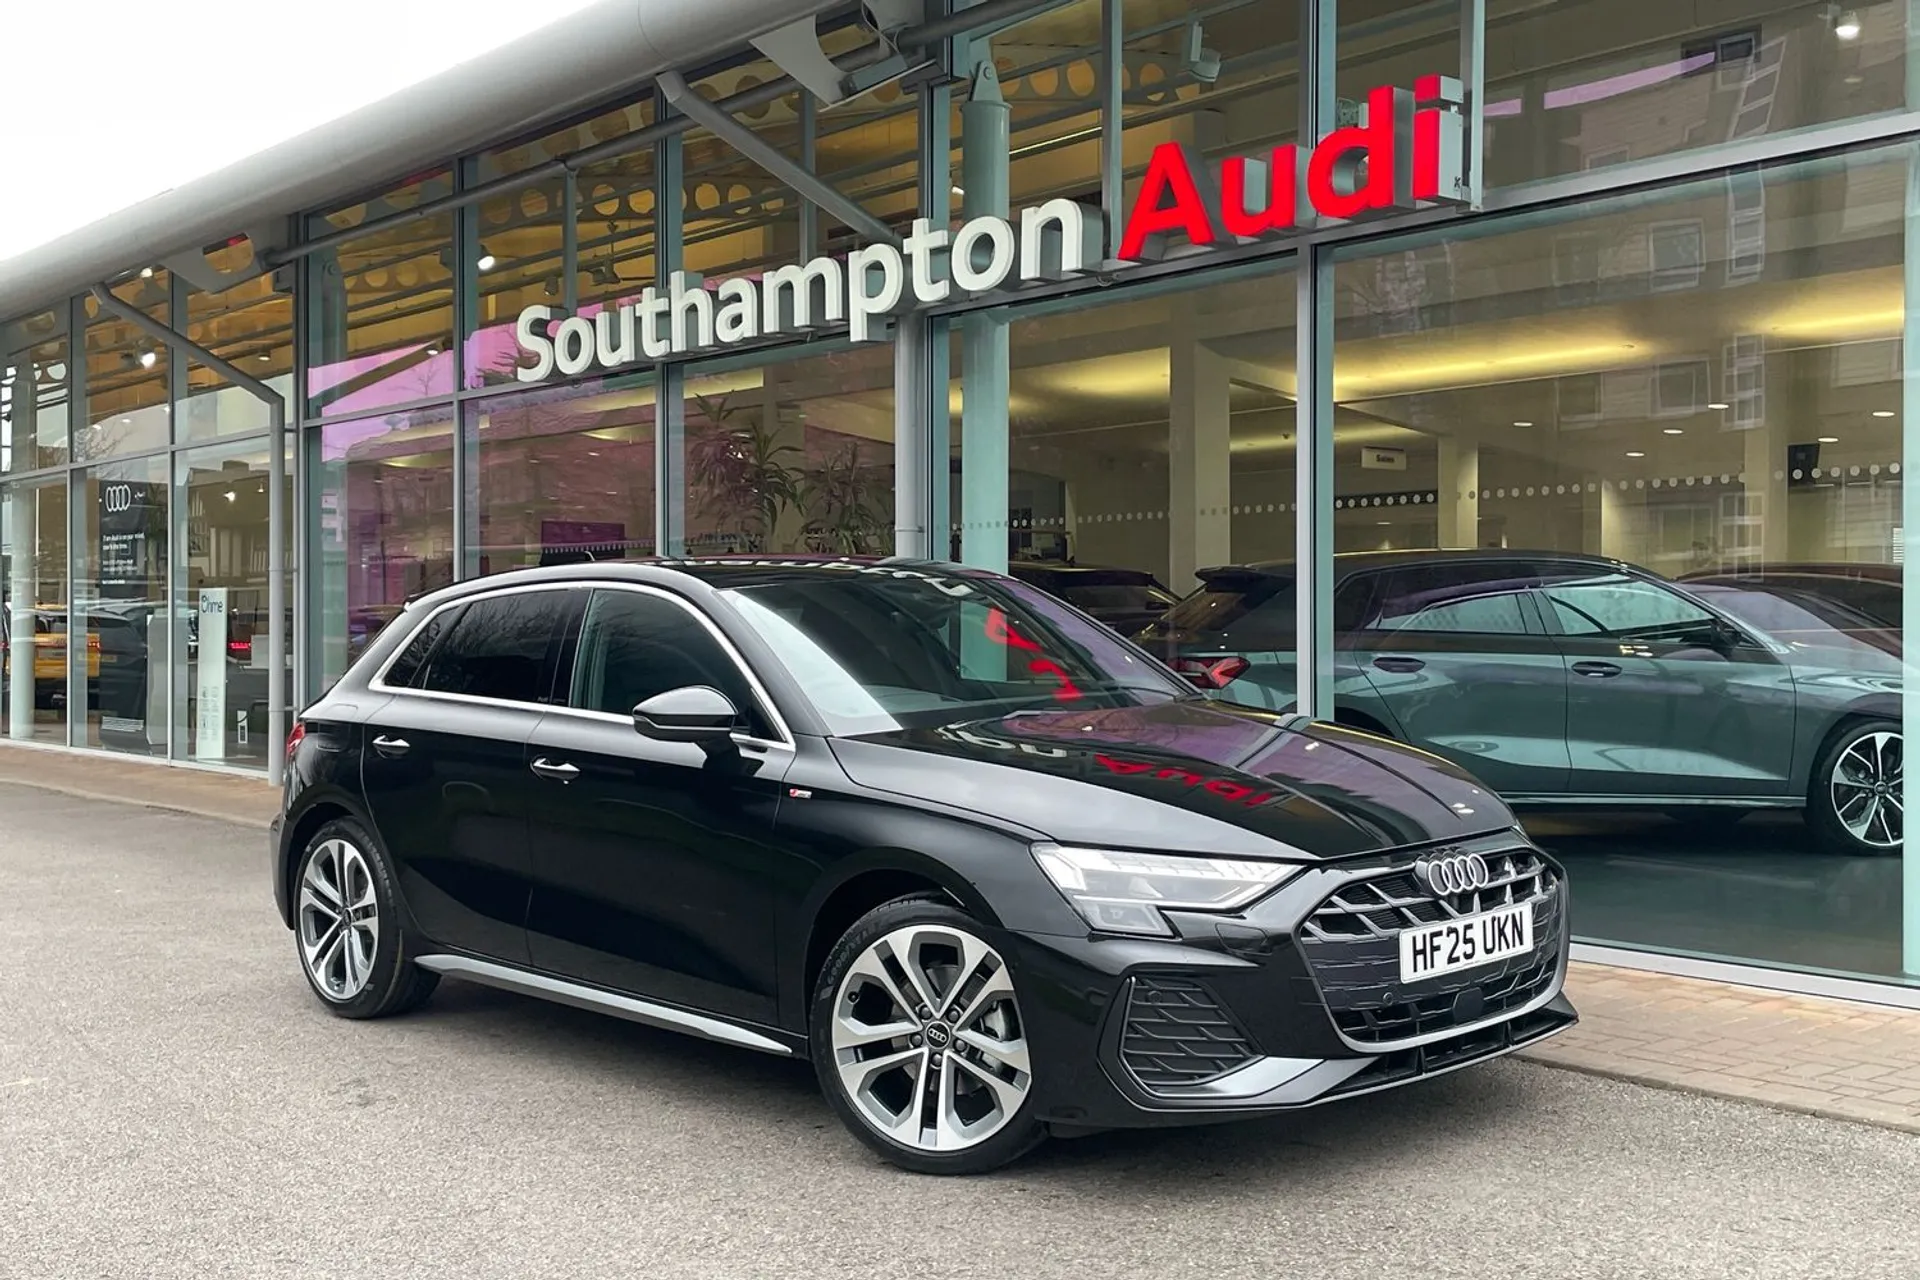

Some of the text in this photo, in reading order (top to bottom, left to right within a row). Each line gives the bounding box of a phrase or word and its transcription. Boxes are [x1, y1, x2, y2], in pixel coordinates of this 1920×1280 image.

[516, 74, 1440, 383] Southampton Audi
[1412, 910, 1525, 974] HF25 UKN
